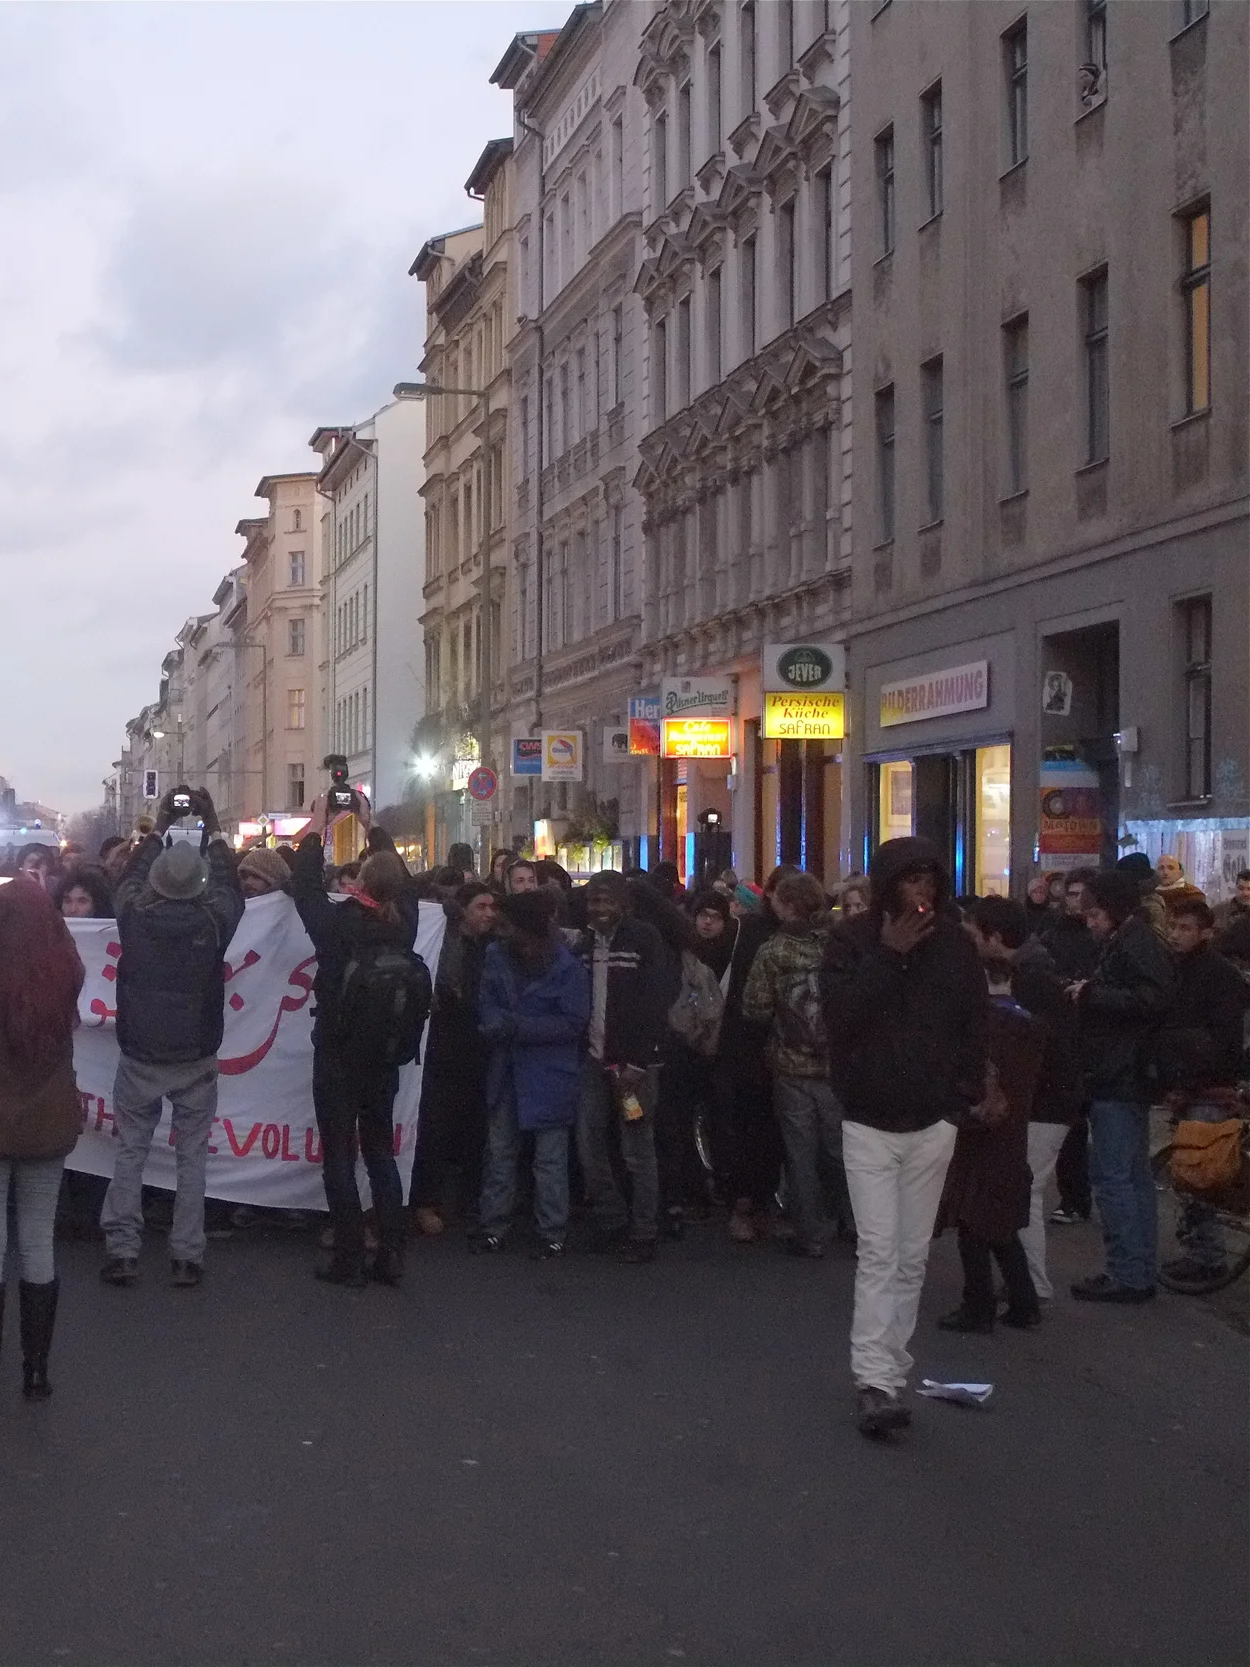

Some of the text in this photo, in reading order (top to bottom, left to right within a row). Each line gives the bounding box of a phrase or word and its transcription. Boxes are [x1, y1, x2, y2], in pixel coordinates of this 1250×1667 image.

[788, 663, 822, 682] JEVER
[666, 691, 698, 712] Pilsner
[771, 696, 840, 707] Persische
[881, 670, 984, 717] BILDERRAHMUNG
[783, 708, 829, 719] Küche
[779, 719, 831, 735] SAFRAN
